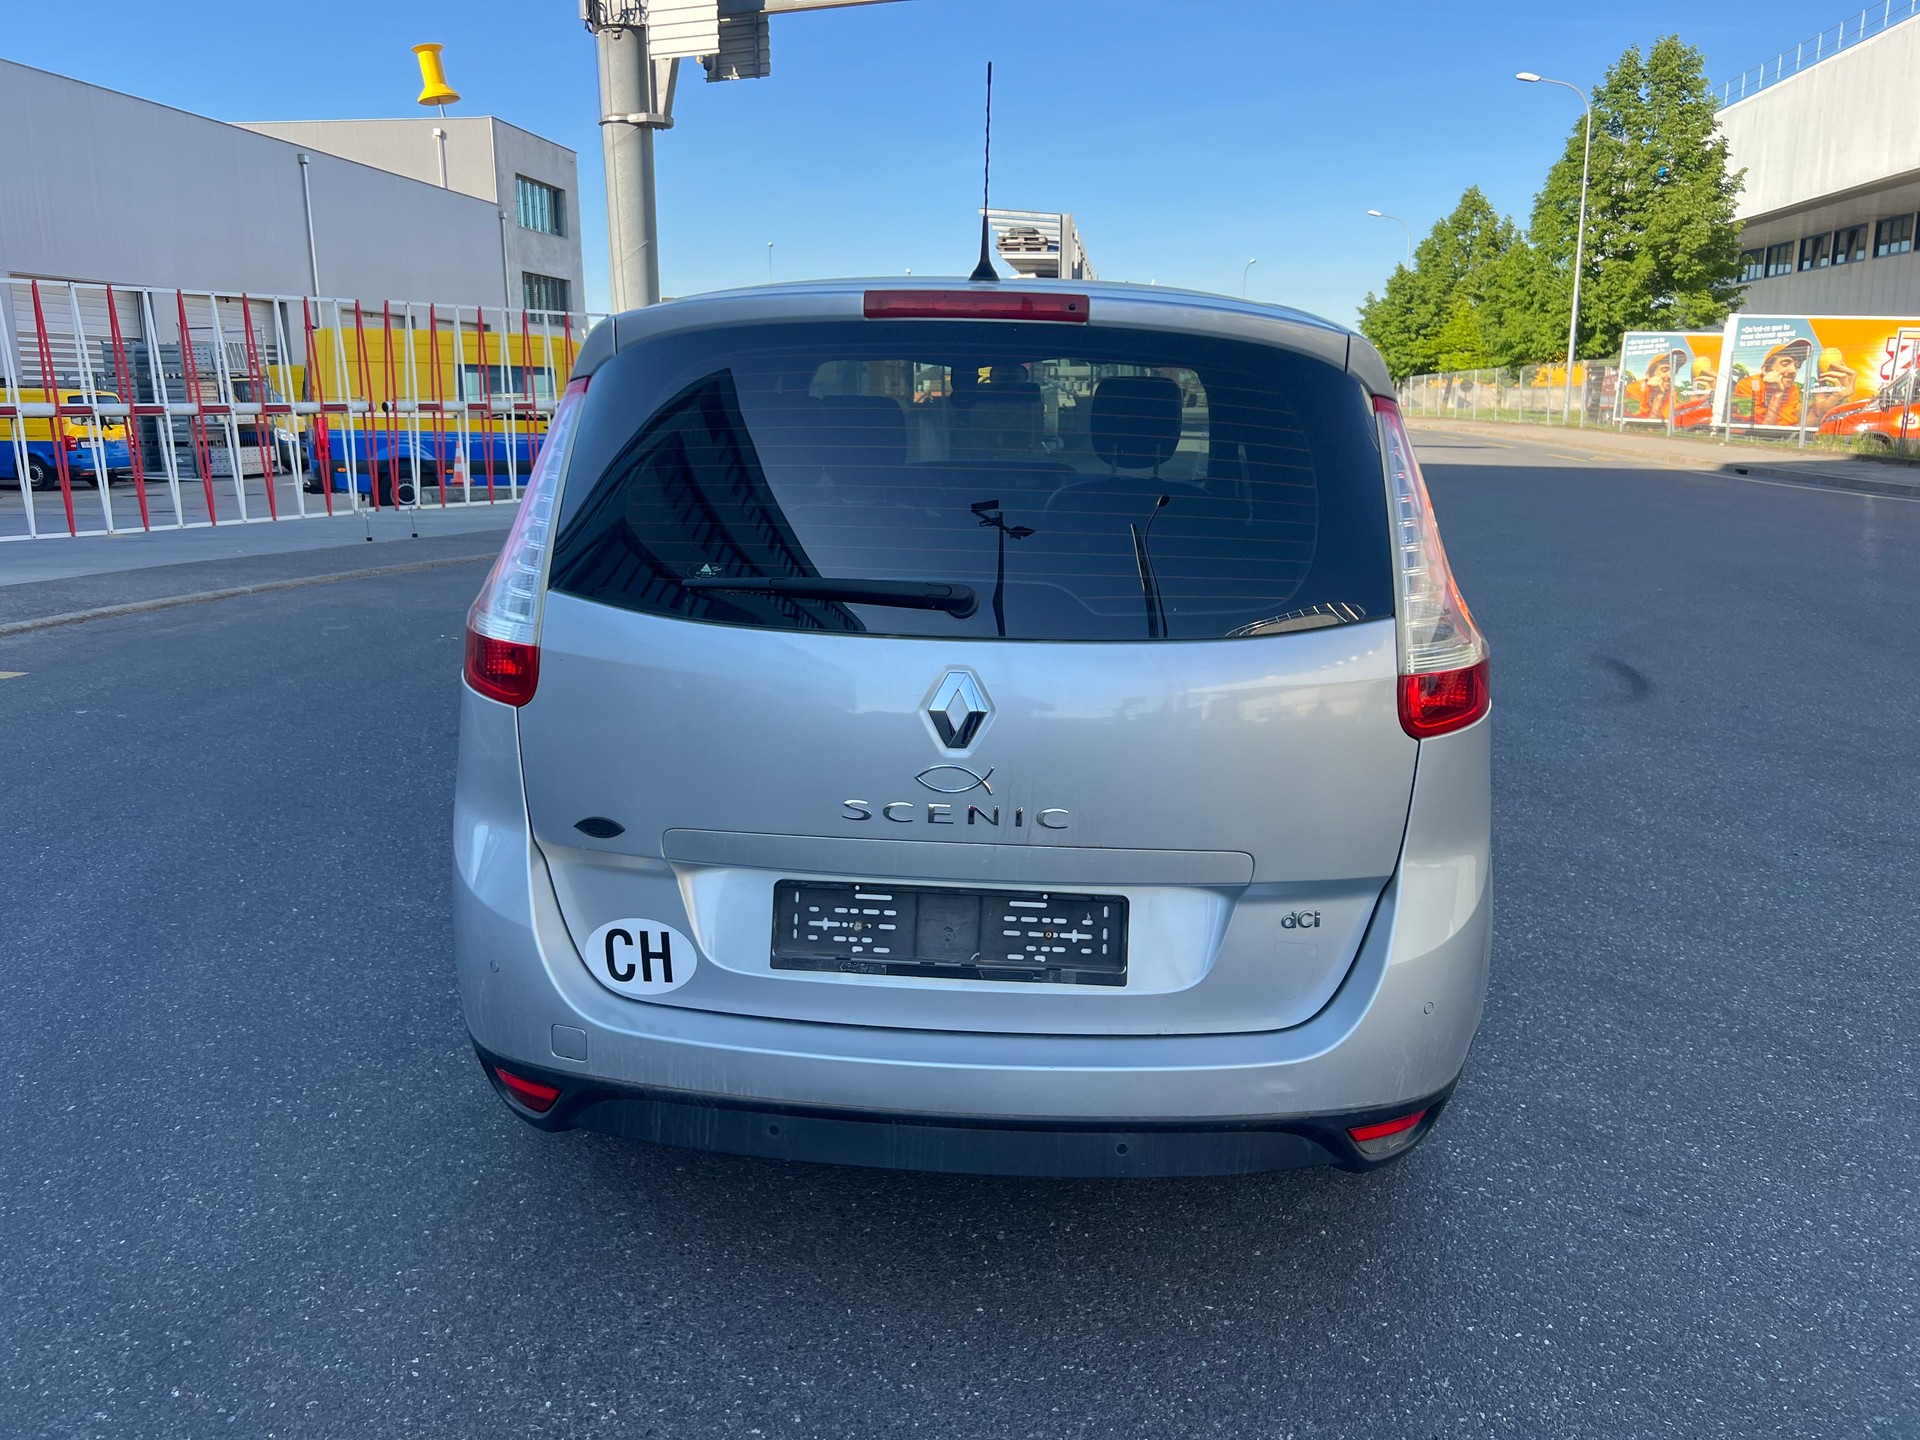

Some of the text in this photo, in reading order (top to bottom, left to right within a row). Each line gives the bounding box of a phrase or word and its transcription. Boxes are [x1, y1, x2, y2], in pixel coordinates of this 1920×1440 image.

[842, 799, 1069, 829] SCENIC
[1281, 910, 1320, 929] dCi
[605, 928, 673, 983] CH
